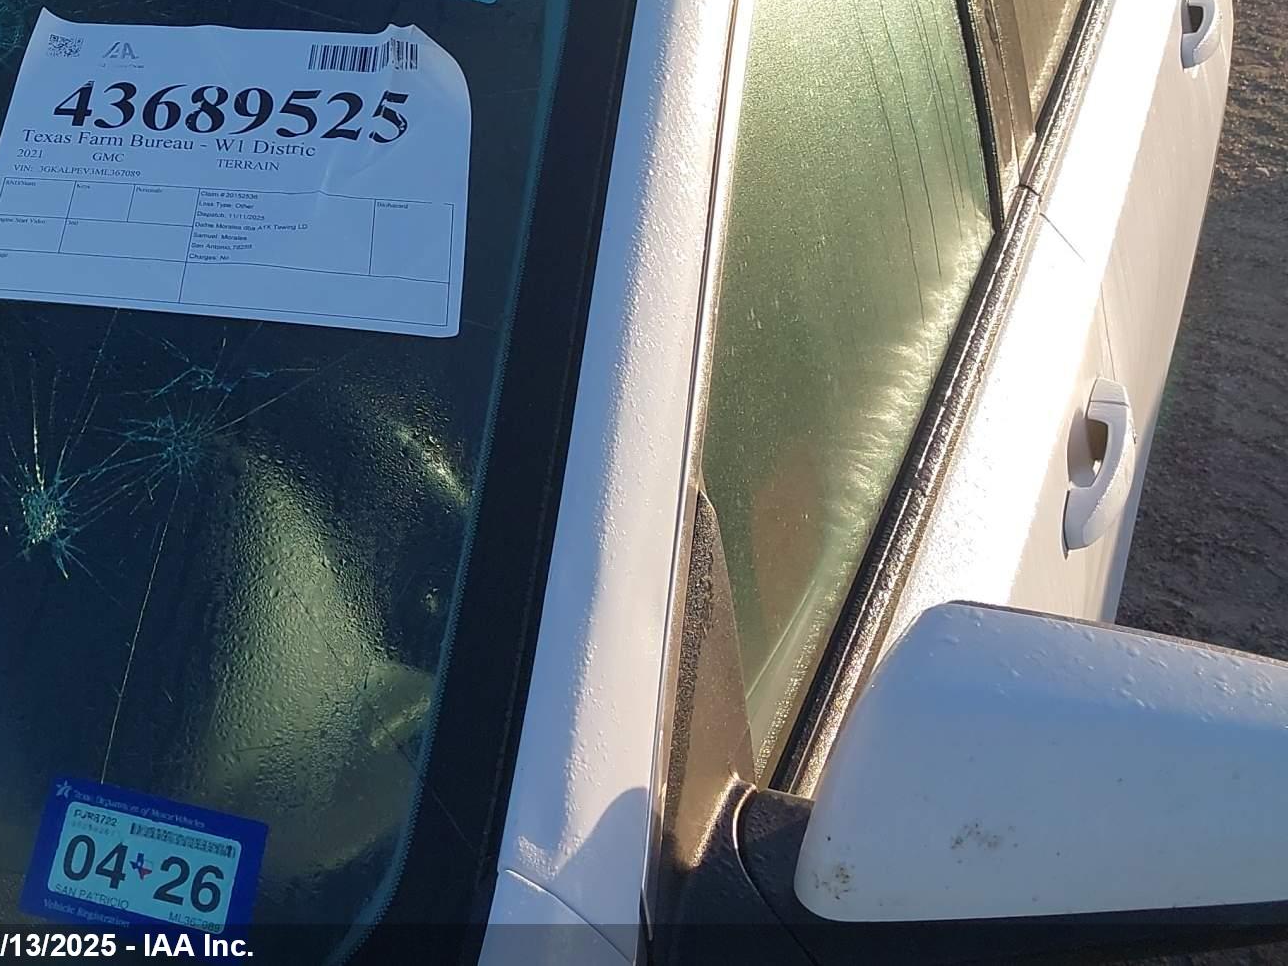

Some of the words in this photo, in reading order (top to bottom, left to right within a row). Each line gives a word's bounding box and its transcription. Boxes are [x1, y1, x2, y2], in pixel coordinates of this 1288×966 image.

[53, 80, 409, 144] 43689525
[22, 129, 72, 144] Texas
[78, 132, 123, 146] Farm
[130, 134, 195, 150] Bureau
[253, 140, 316, 158] Distric
[14, 164, 33, 172] VIN:
[17, 147, 44, 159] 2021
[92, 151, 124, 164] GMC
[216, 158, 280, 171] TERRAIN
[63, 834, 128, 890] 04
[152, 856, 225, 914] 26
[80, 889, 130, 911] PATRICIO
